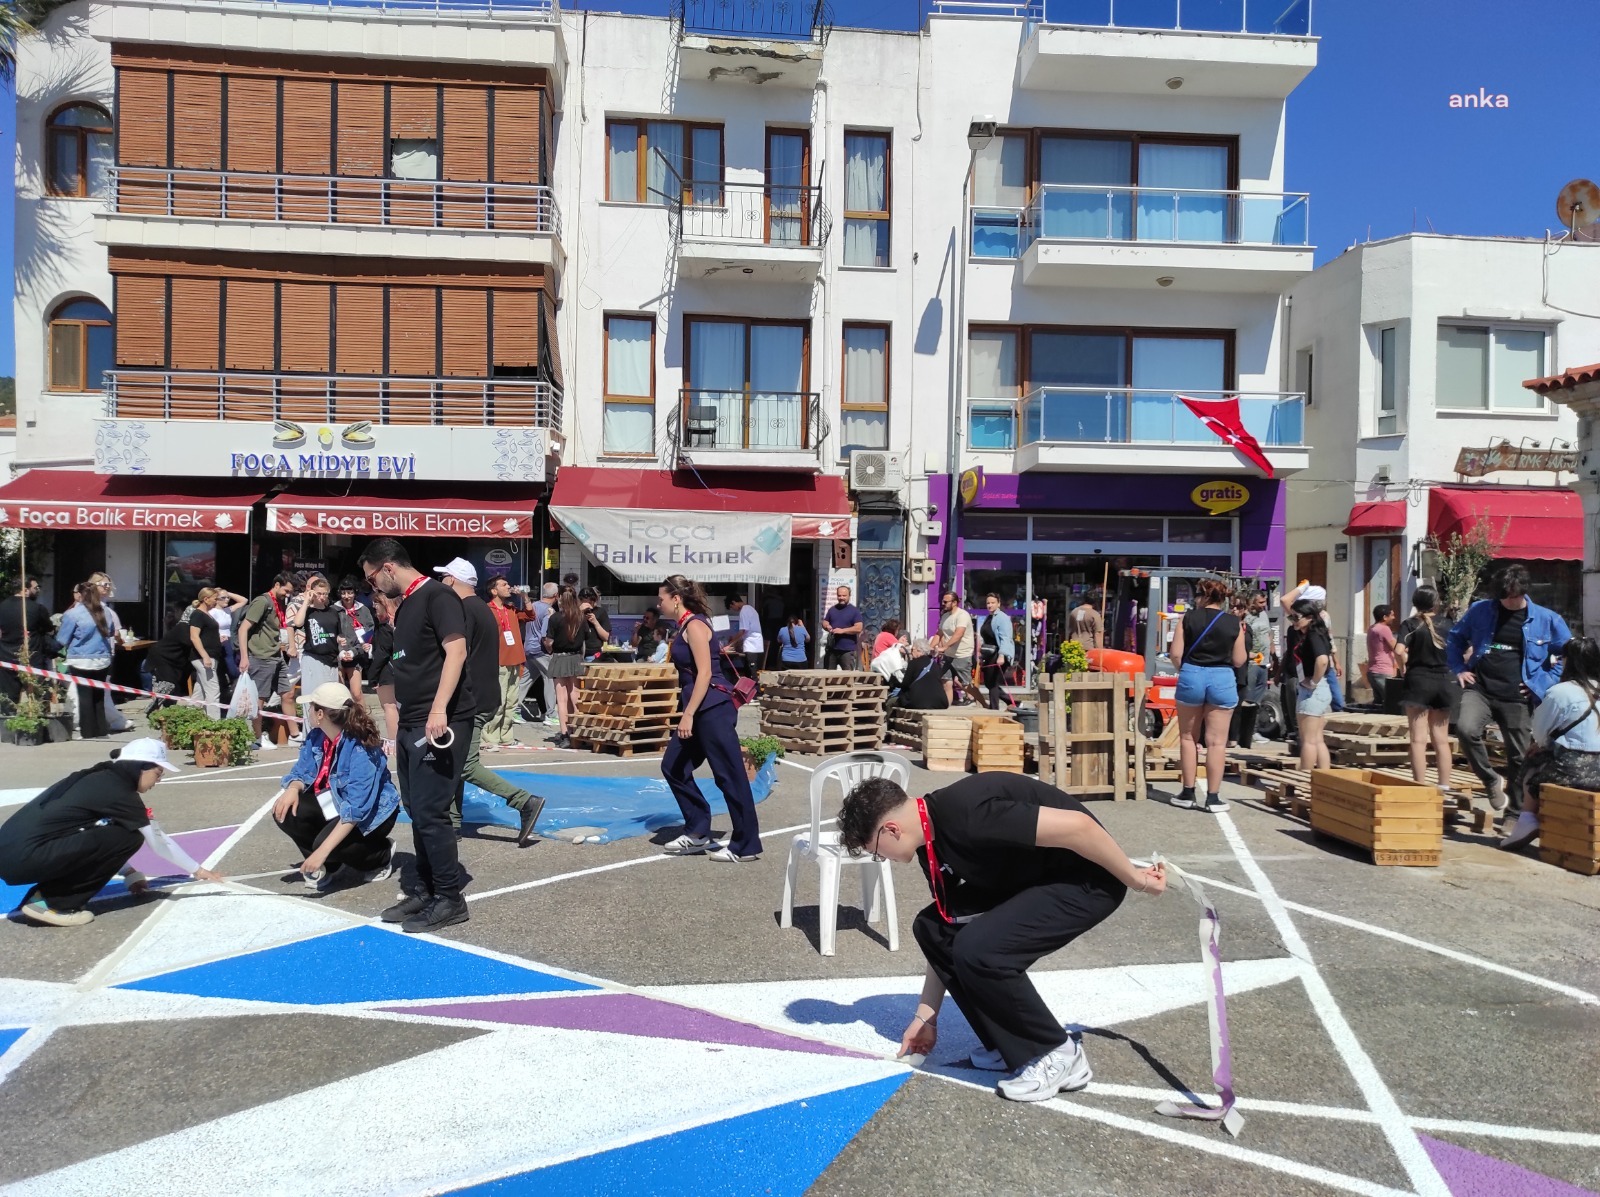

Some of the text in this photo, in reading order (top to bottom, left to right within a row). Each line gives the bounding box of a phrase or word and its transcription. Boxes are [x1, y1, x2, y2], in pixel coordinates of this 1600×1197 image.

[231, 451, 416, 475] FOÇA MİDYE EVİ
[1200, 485, 1243, 502] gratis
[19, 507, 204, 528] Foça Balık Ekmek
[317, 512, 492, 532] Foça Balık Ekmek
[628, 519, 715, 542] Foça
[593, 543, 754, 565] Balık Ekmek
